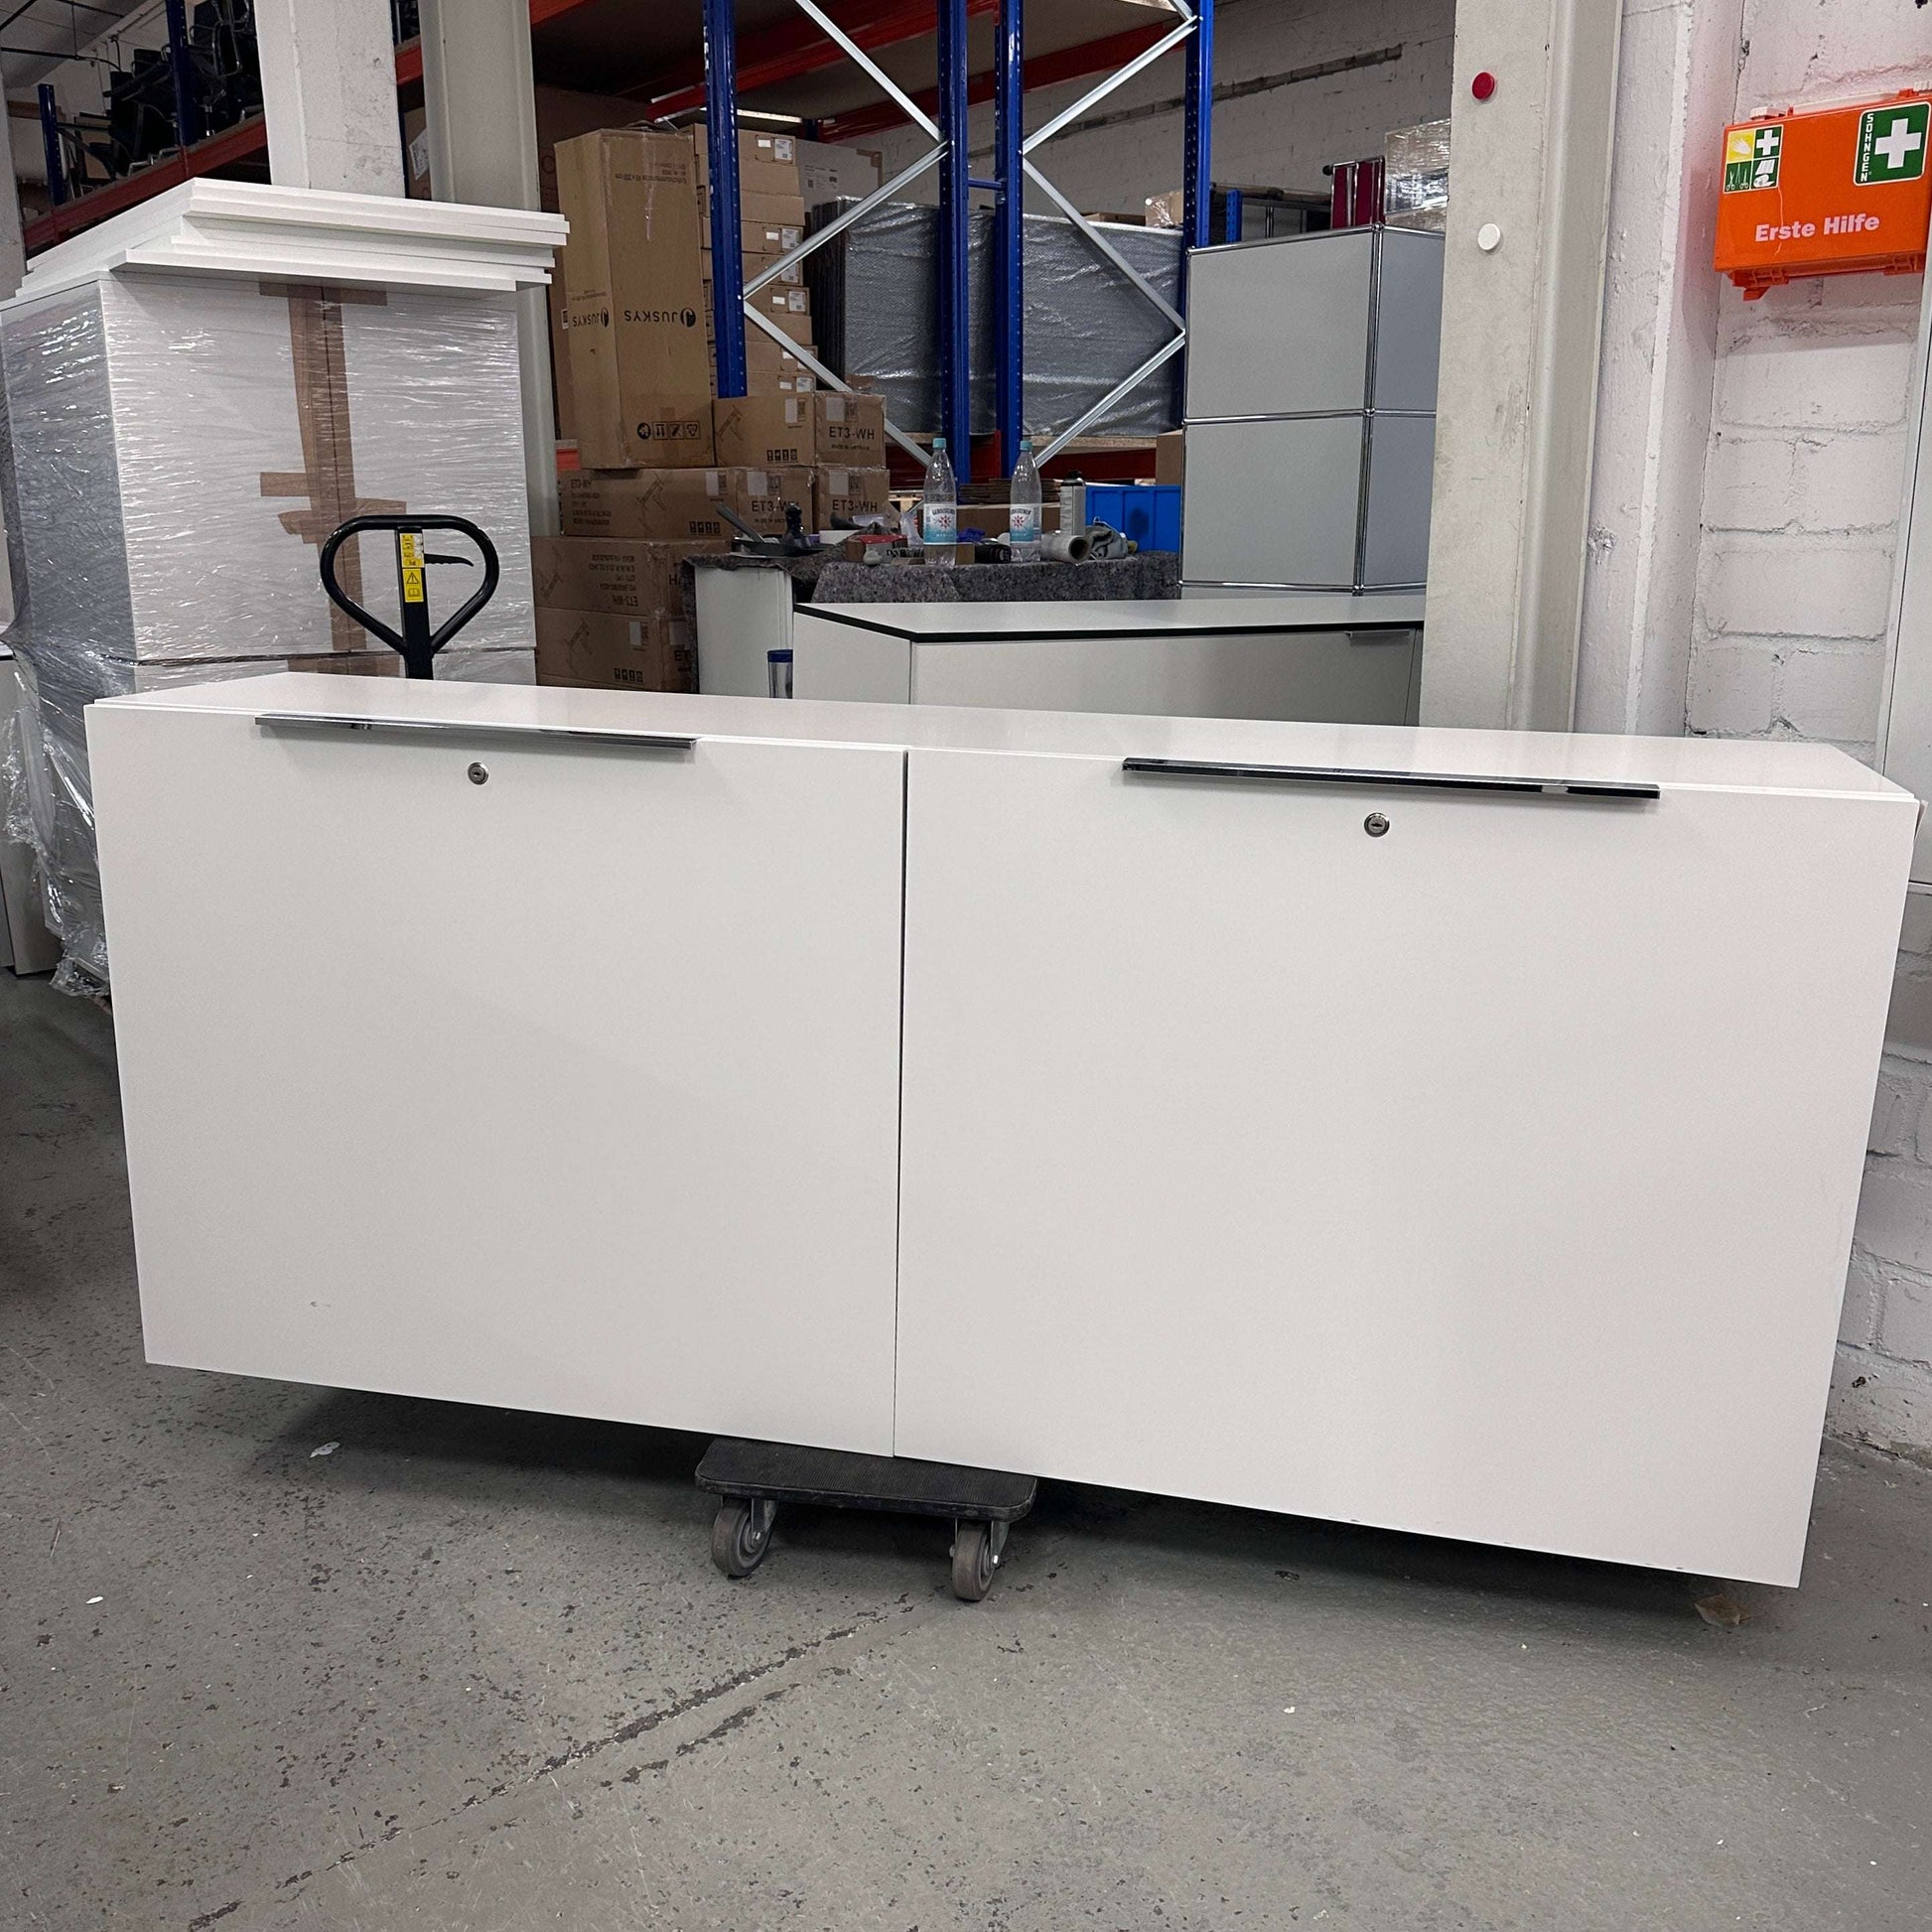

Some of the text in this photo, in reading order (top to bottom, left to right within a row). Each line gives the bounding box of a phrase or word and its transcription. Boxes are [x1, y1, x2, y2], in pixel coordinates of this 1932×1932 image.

[1754, 212, 1880, 242] Erste Hilfe
[572, 312, 600, 328] JUSKYS
[623, 310, 678, 323] JUSKYS
[829, 426, 875, 440] ET3-WH
[752, 499, 800, 512] ET3-W
[832, 499, 878, 512] ET3-WH
